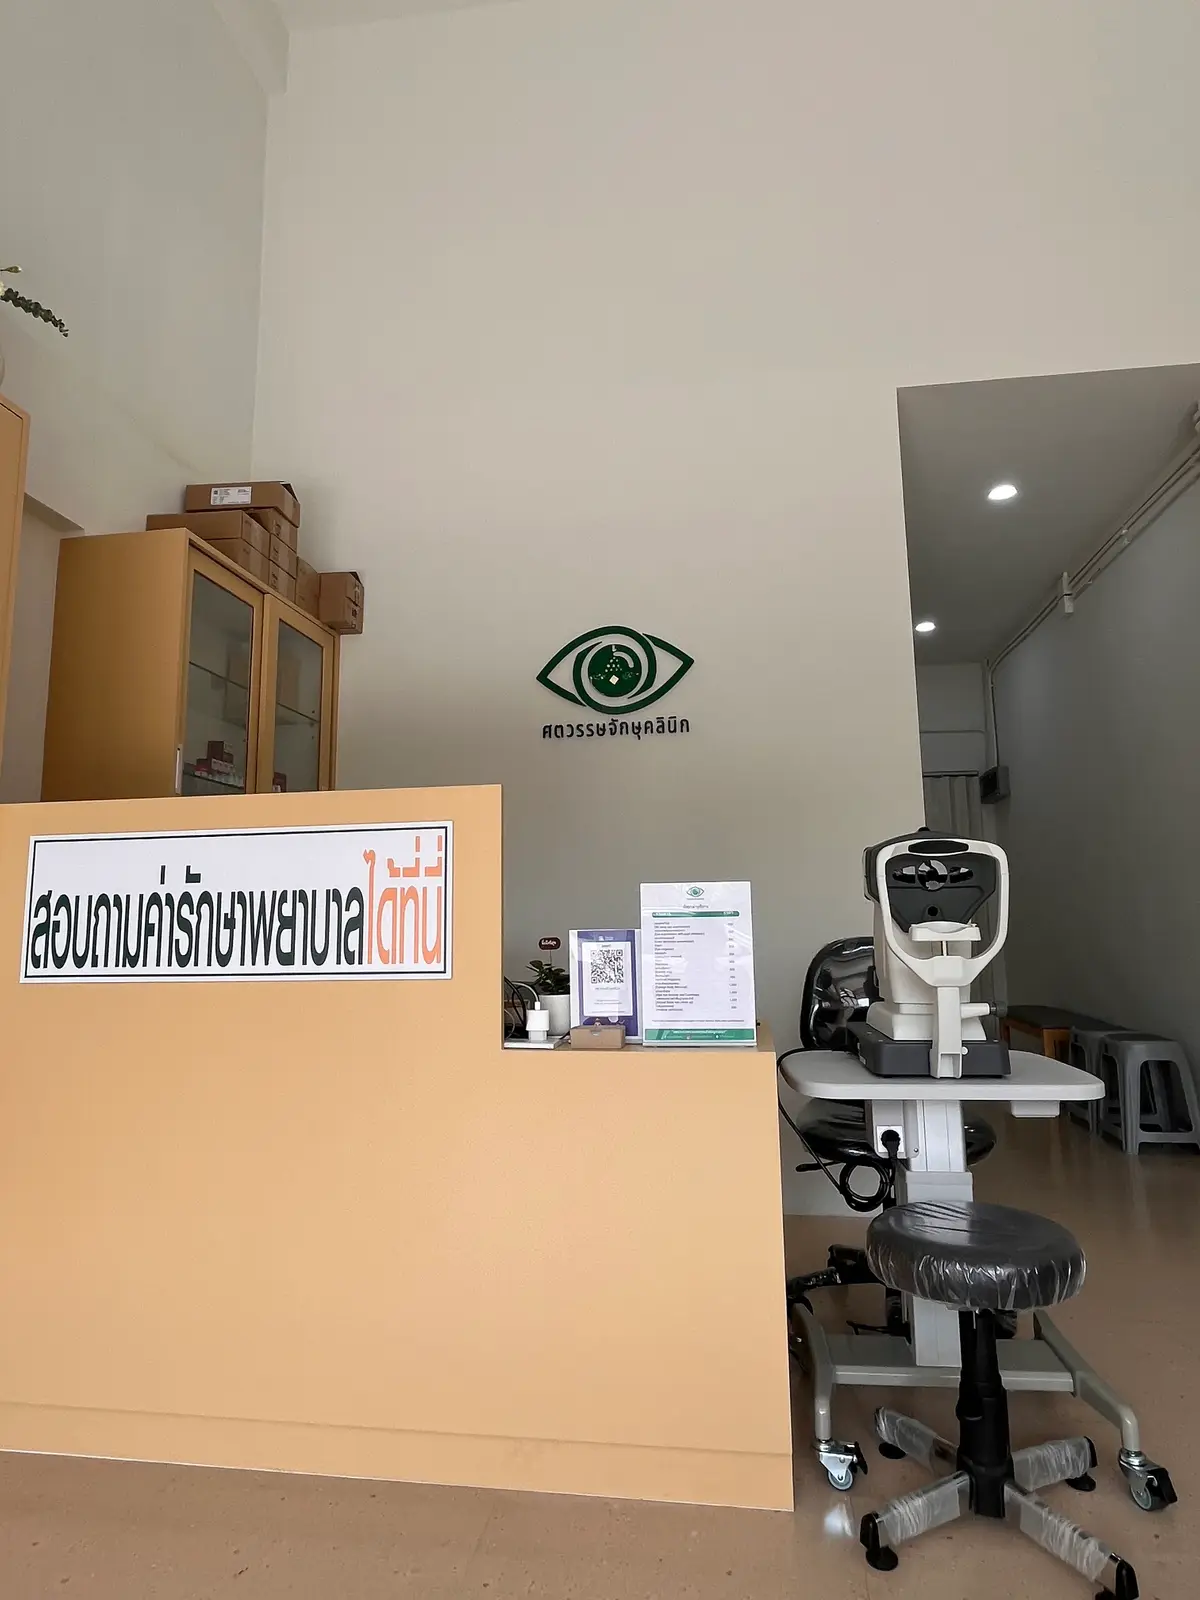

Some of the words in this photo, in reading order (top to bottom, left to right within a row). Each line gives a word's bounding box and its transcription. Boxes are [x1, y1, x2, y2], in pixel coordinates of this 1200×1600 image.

[542, 716, 690, 740] ศตวรรษจักษุคลินิก
[31, 835, 443, 969] สอบถามค่ารักษาพยาบาลได้ที่นี่
